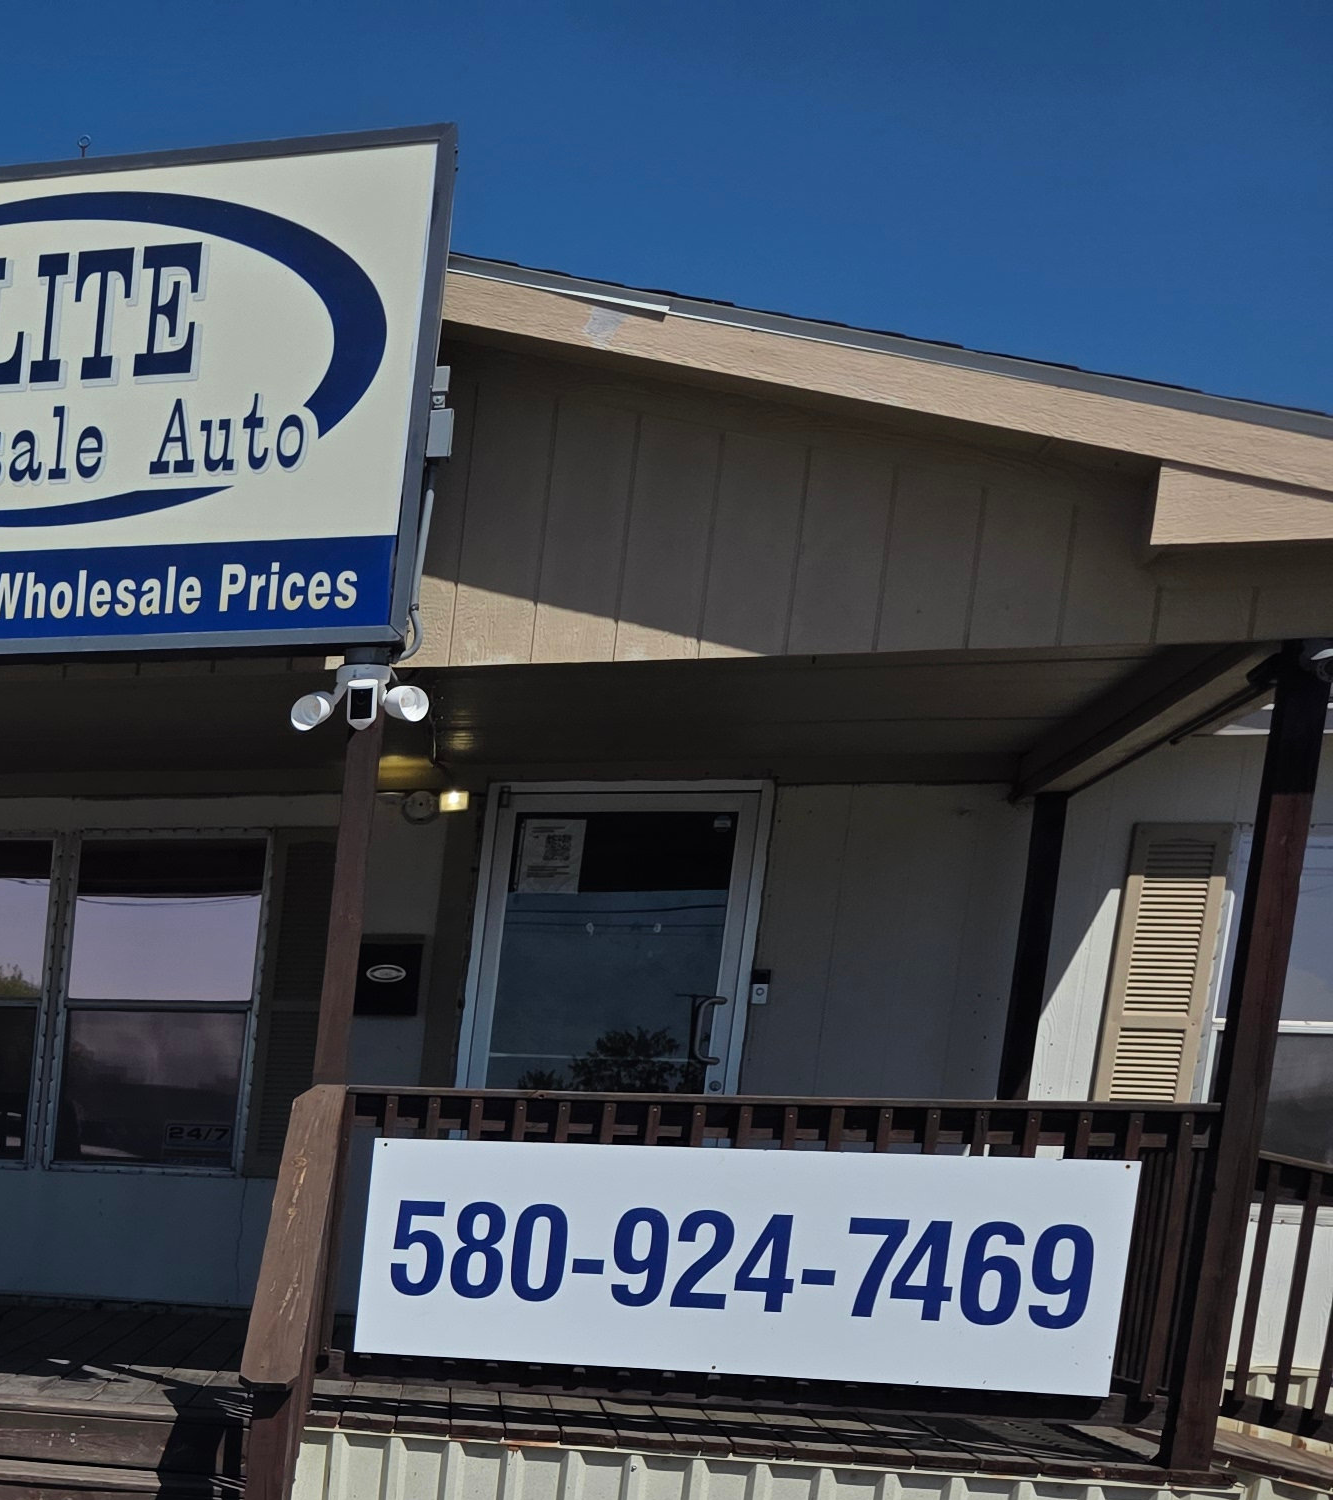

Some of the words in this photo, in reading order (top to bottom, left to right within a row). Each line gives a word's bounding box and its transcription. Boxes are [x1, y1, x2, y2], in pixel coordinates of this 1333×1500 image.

[149, 393, 307, 476] Auto
[218, 561, 359, 613] Prices
[168, 1126, 230, 1141] 24/7
[389, 1199, 1095, 1330] 580-924-7469
